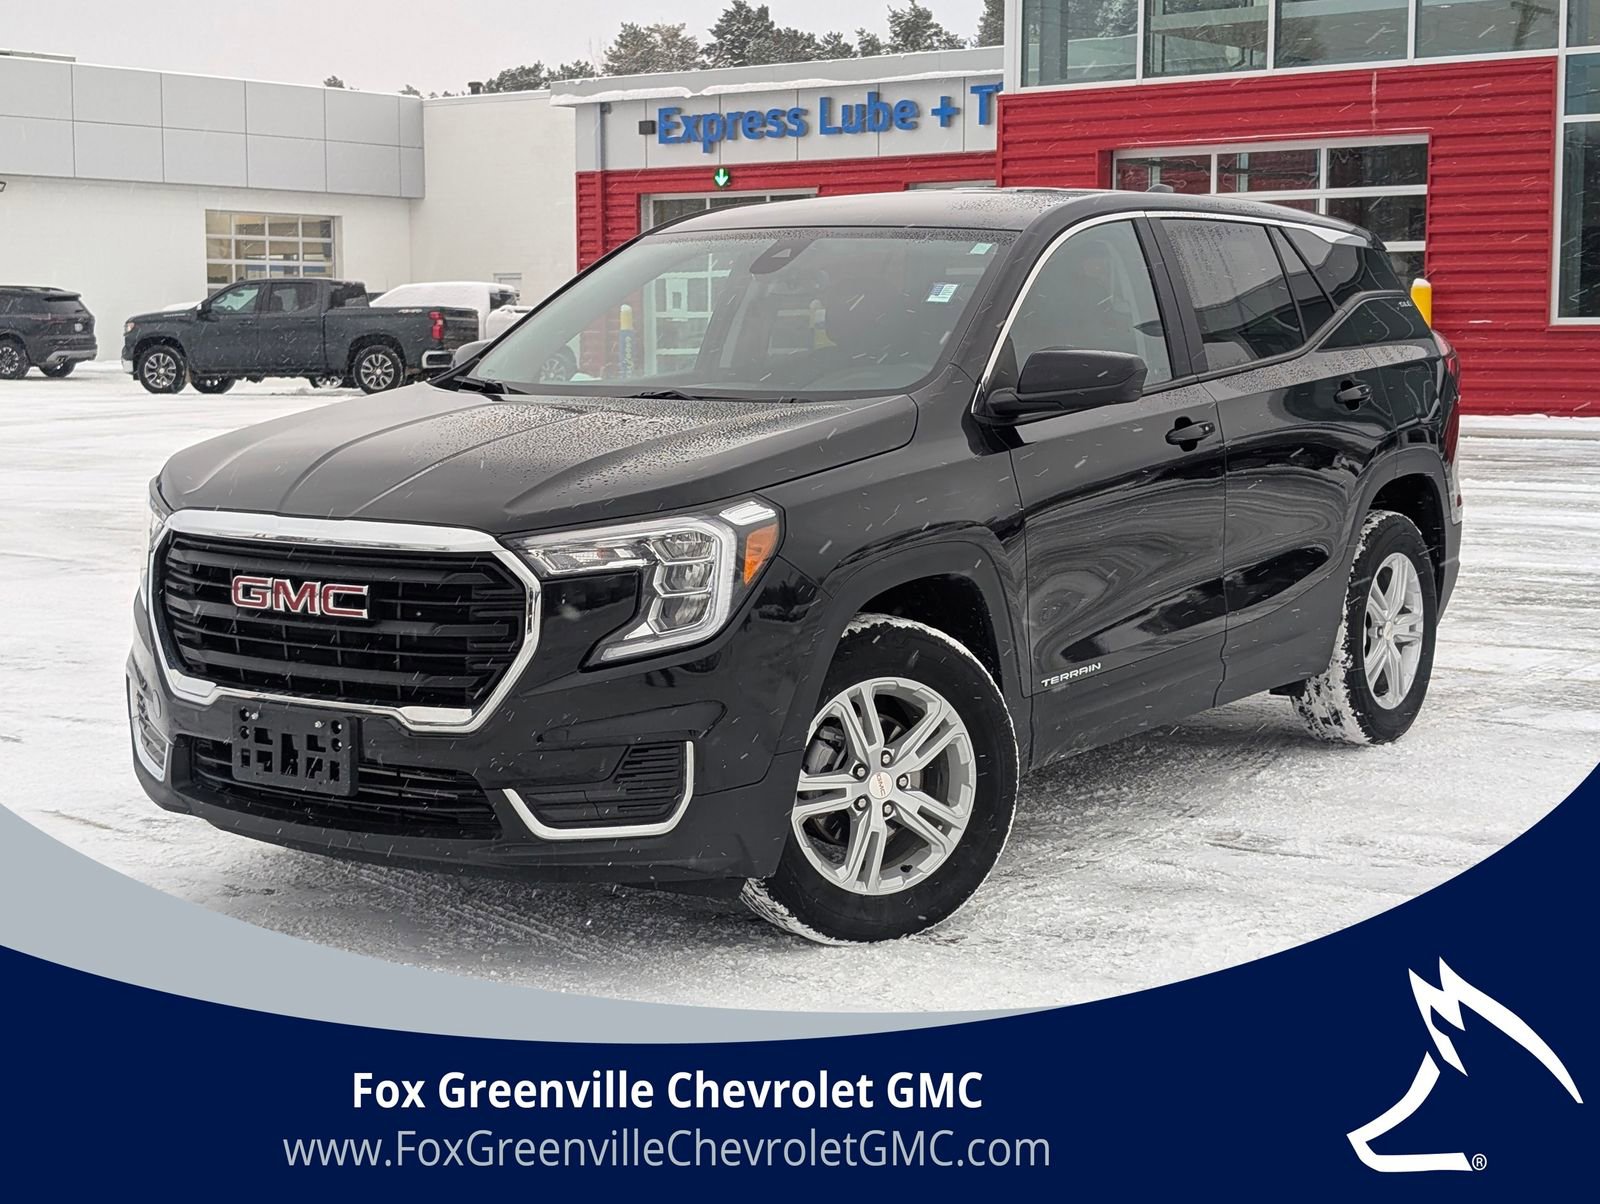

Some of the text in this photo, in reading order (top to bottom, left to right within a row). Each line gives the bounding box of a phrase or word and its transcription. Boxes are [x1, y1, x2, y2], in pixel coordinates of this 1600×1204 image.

[658, 81, 1004, 153] Express Lube + T
[231, 574, 370, 620] GMC
[1040, 661, 1102, 688] TERRAIN
